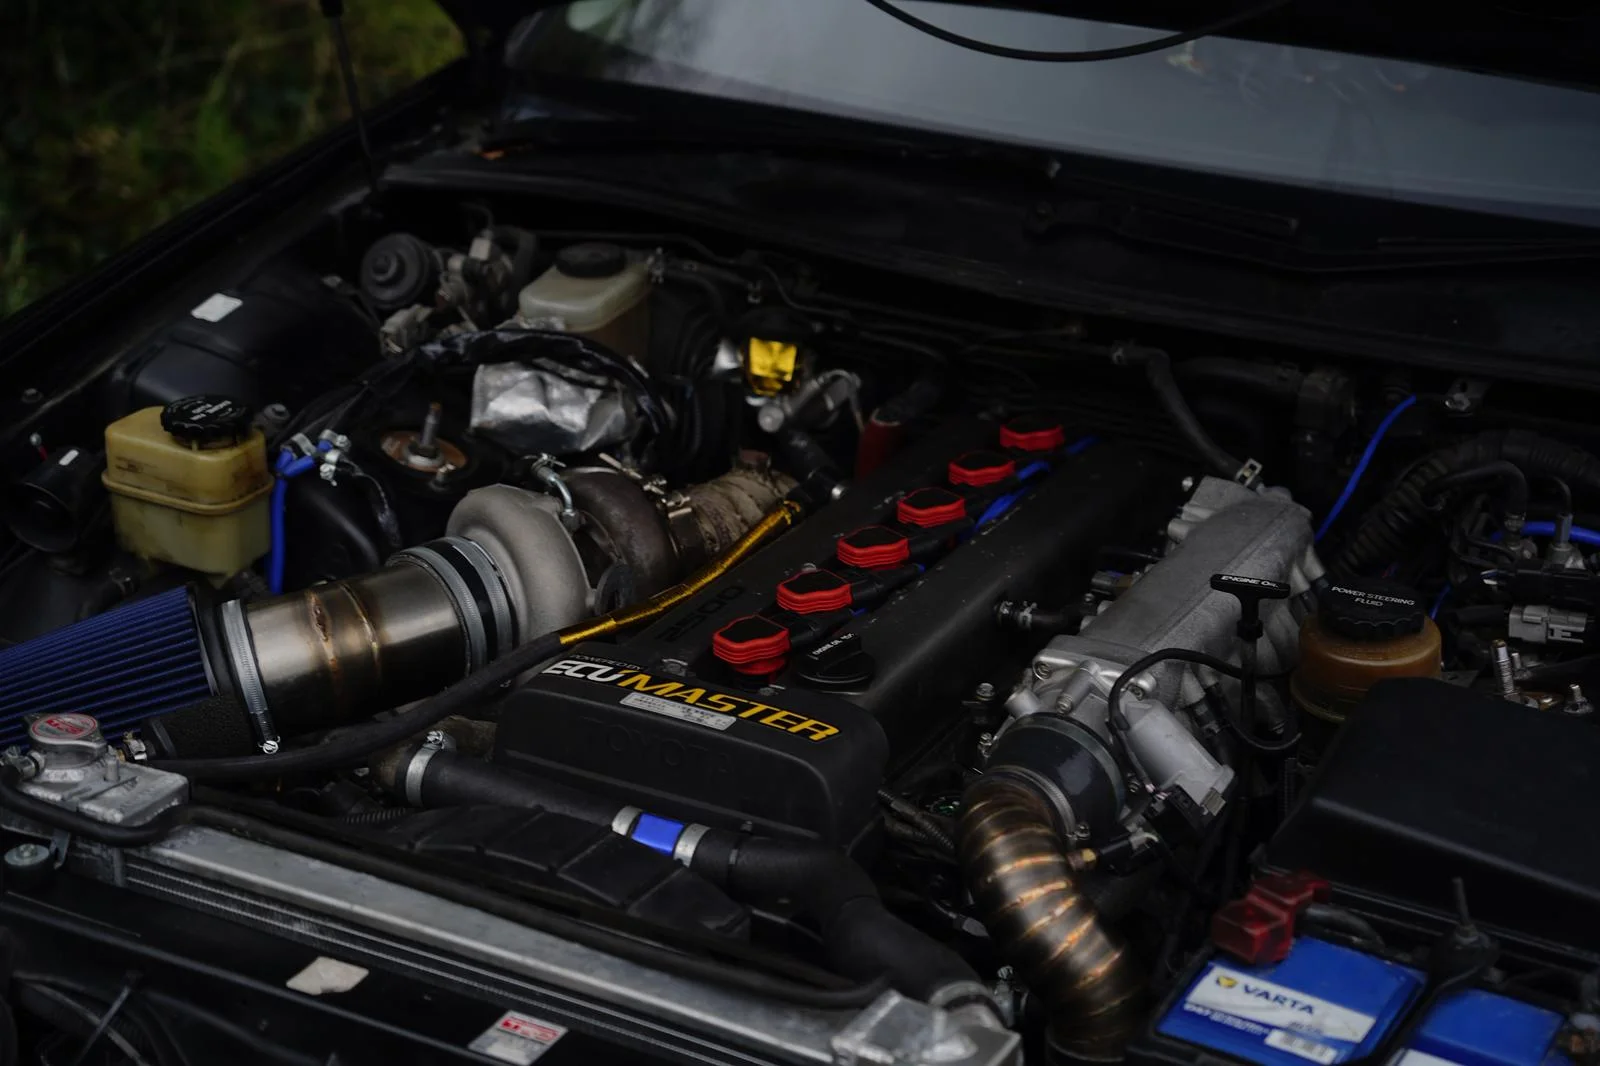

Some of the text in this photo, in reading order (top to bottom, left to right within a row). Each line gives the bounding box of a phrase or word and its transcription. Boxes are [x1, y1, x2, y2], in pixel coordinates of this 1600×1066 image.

[1331, 586, 1415, 606] POWER STEERING
[1354, 597, 1384, 607] FLUID
[1243, 983, 1315, 1015] VARTA
